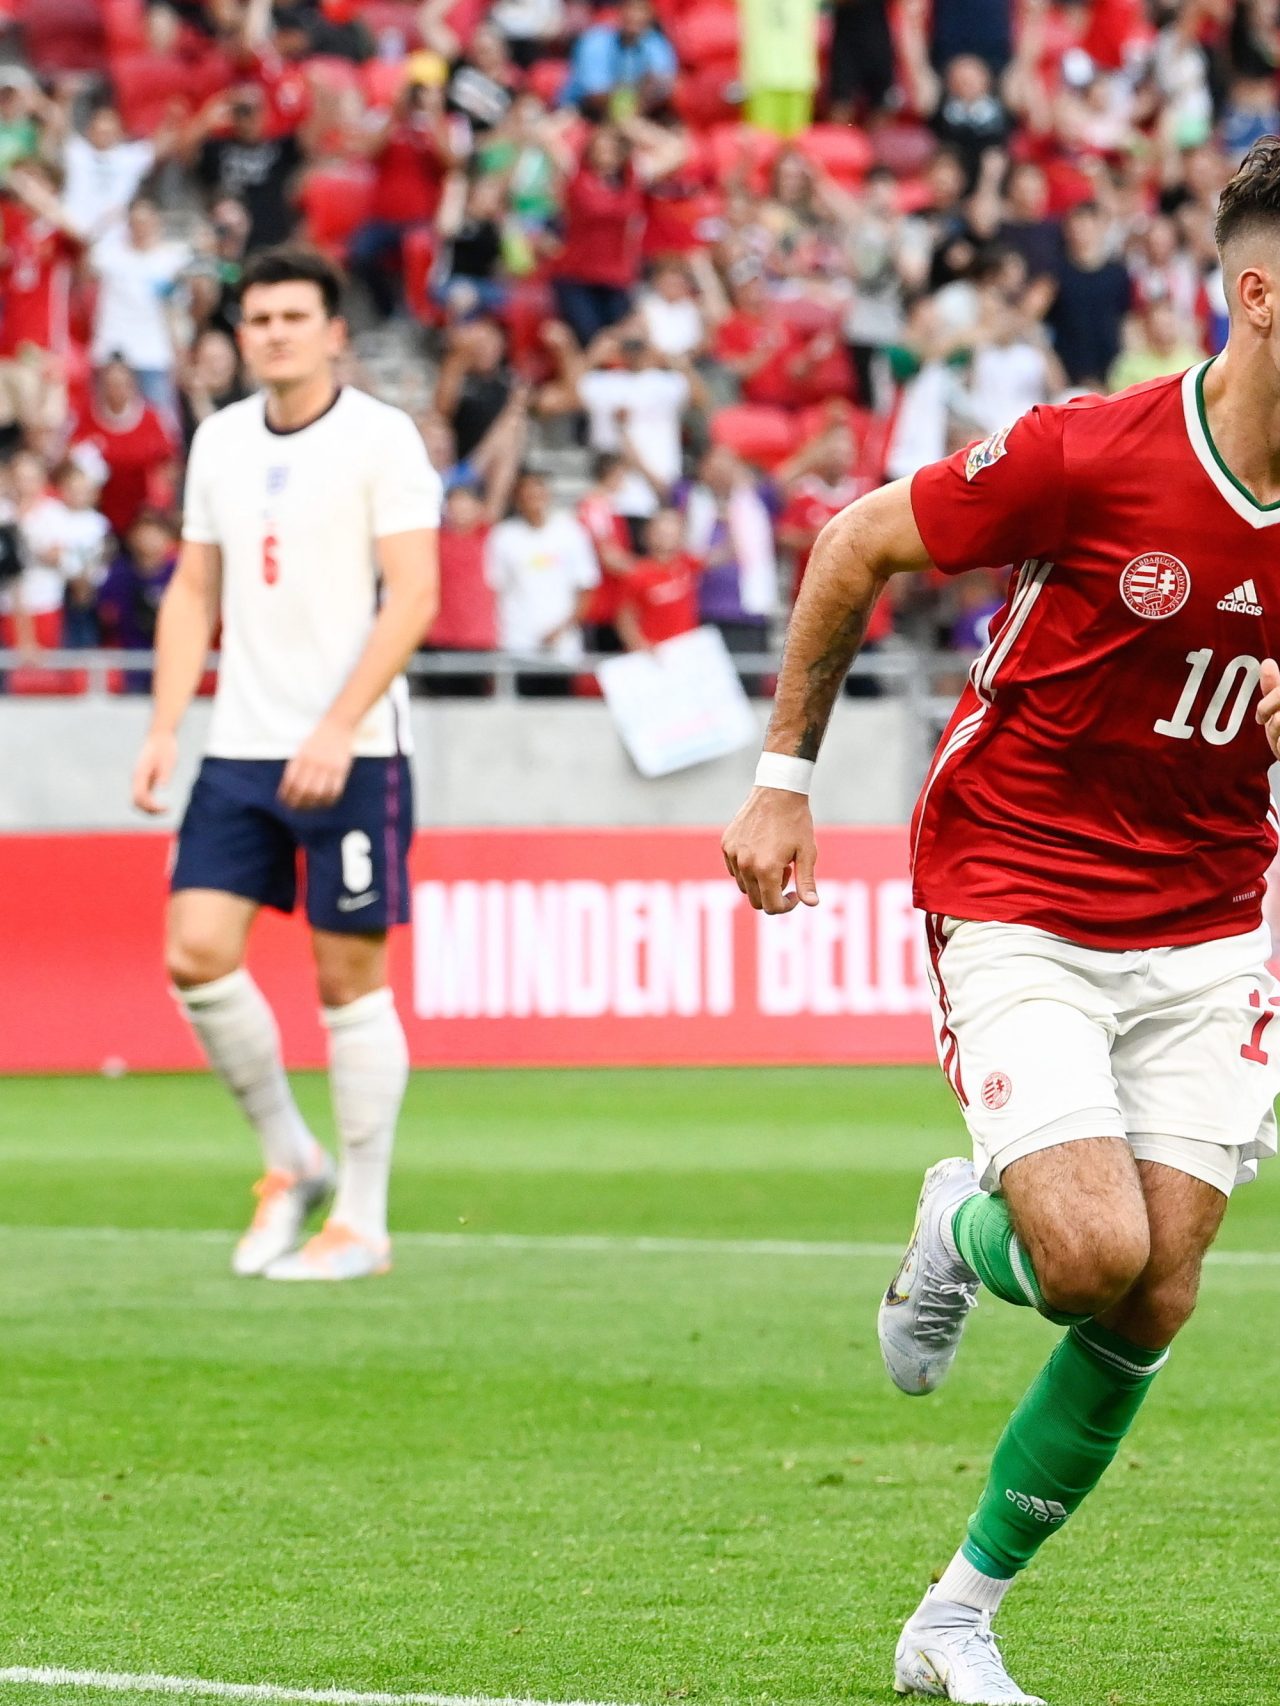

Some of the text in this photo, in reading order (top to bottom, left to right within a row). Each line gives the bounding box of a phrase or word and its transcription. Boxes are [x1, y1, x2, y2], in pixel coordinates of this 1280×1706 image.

[263, 535, 278, 586] 6
[1216, 599, 1263, 616] adidas
[1153, 648, 1261, 746] 10
[341, 829, 373, 894] 6
[413, 880, 741, 1019] MINDENT
